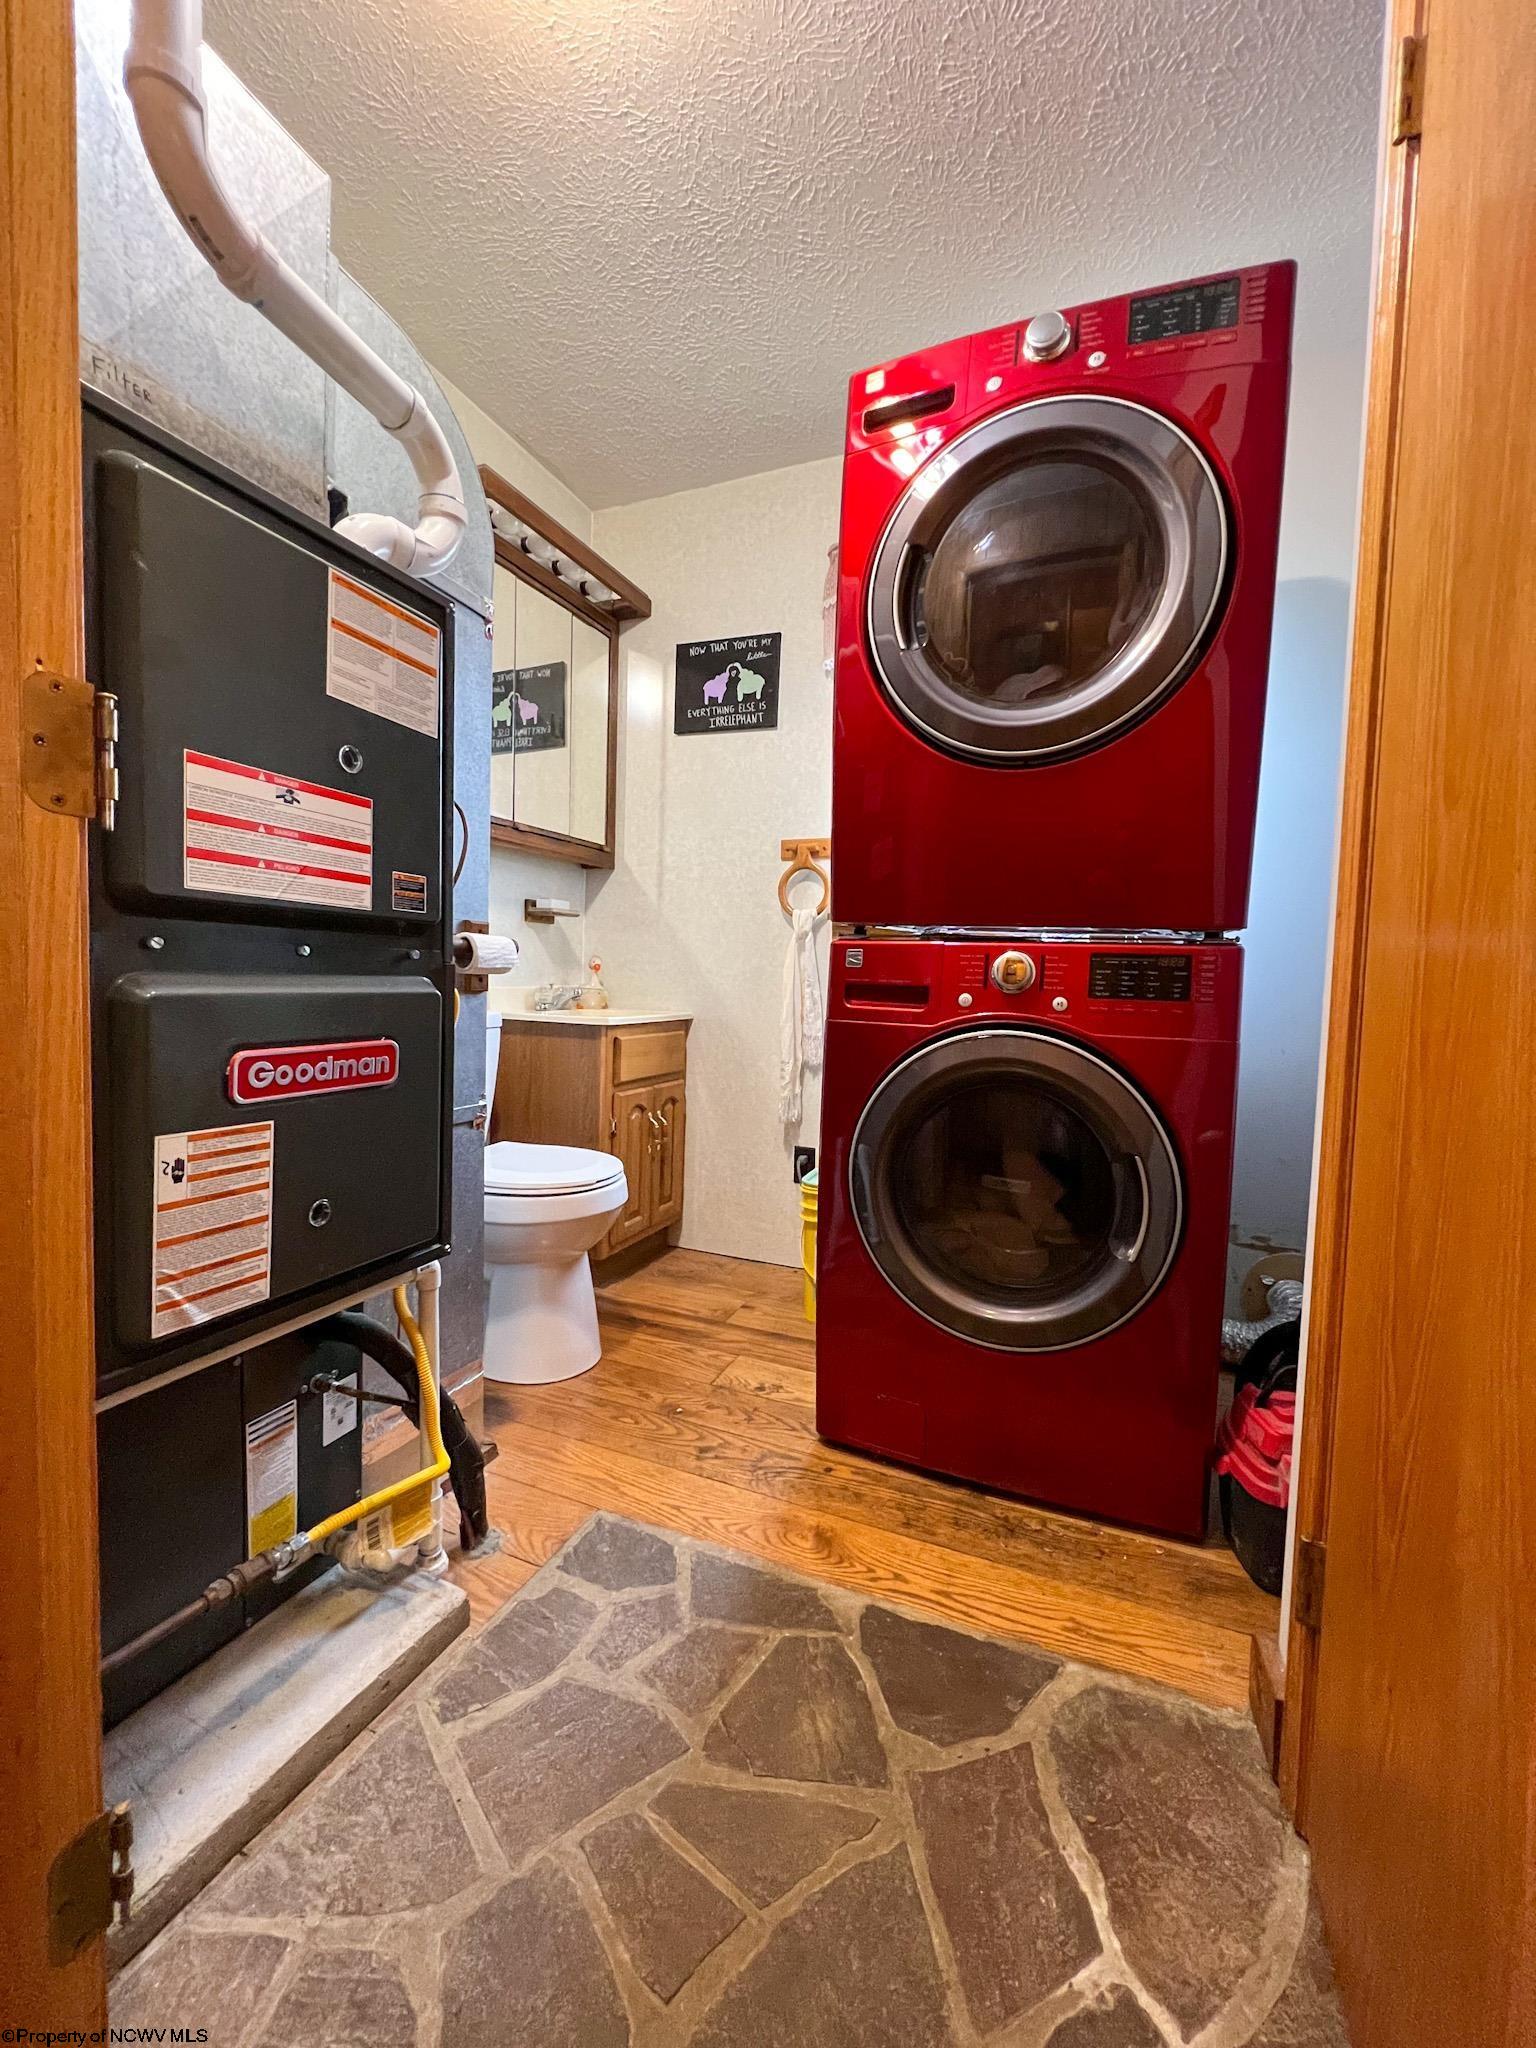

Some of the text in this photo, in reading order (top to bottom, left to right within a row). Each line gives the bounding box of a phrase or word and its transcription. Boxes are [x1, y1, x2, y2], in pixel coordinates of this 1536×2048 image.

[689, 637, 773, 657] NOW THAT YOU'RE MY
[687, 700, 767, 718] EVERYTHING ELSE IS
[709, 712, 764, 728] IRRELEPHANT
[247, 1055, 390, 1088] Goodman
